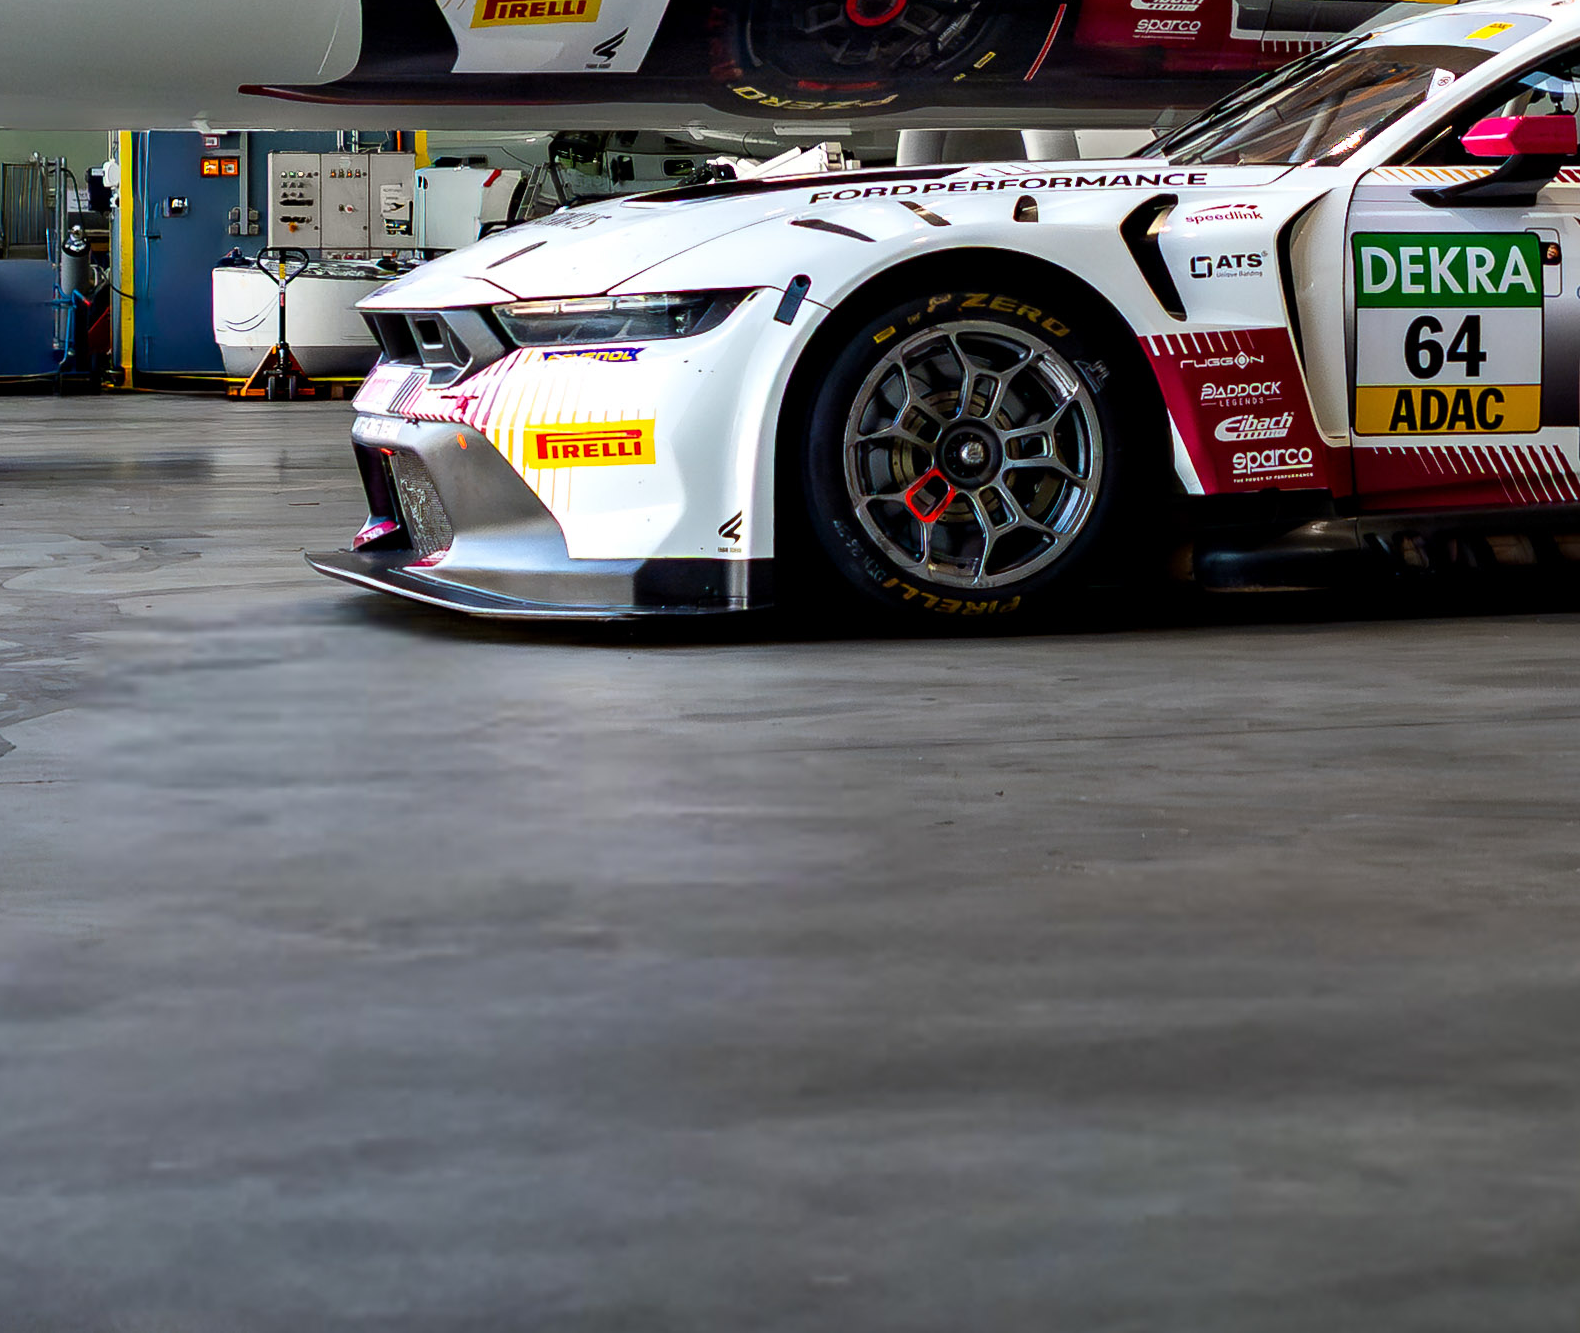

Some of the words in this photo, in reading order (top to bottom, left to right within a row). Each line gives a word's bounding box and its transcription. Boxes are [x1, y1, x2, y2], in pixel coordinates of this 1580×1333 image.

[1137, 19, 1201, 34] sparco
[810, 184, 920, 204] FORD
[922, 172, 1208, 194] PERFORMANCE
[1186, 211, 1263, 224] speedlink
[1216, 253, 1262, 269] ATS
[1360, 245, 1536, 294] DEKRA
[961, 293, 1070, 337] ZERO
[1404, 315, 1487, 380] 64
[1389, 388, 1505, 432] ADAC
[1214, 412, 1293, 441] Eibach
[536, 429, 642, 460] PIRELLI
[1232, 447, 1313, 474] sparco
